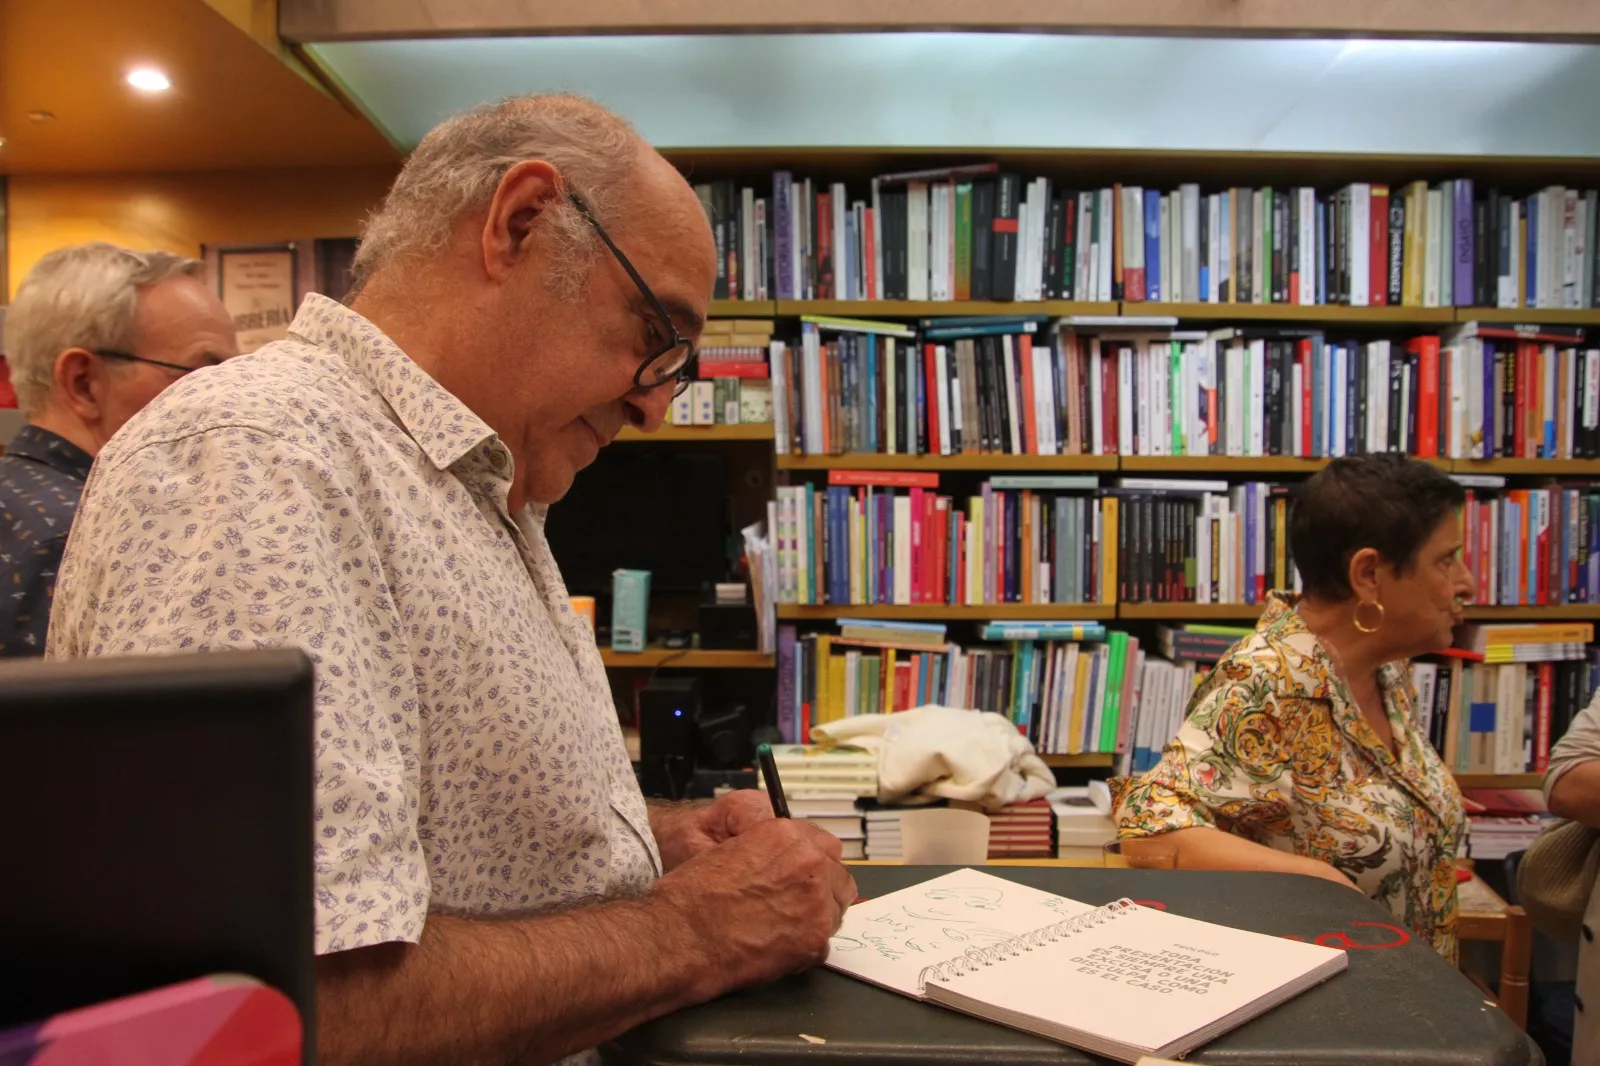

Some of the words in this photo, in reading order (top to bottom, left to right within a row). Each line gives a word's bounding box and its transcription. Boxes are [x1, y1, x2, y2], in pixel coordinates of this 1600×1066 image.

[1160, 949, 1202, 963] TODA
[1076, 966, 1100, 975] ES
[1100, 973, 1120, 982] EL
[1086, 953, 1152, 974] EXCUSA
[1174, 975, 1211, 988] UNA
[1091, 947, 1114, 956] ES
[1115, 953, 1191, 975] SIEMPRE
[1191, 971, 1228, 985] UNA
[1157, 979, 1208, 995] COMO
